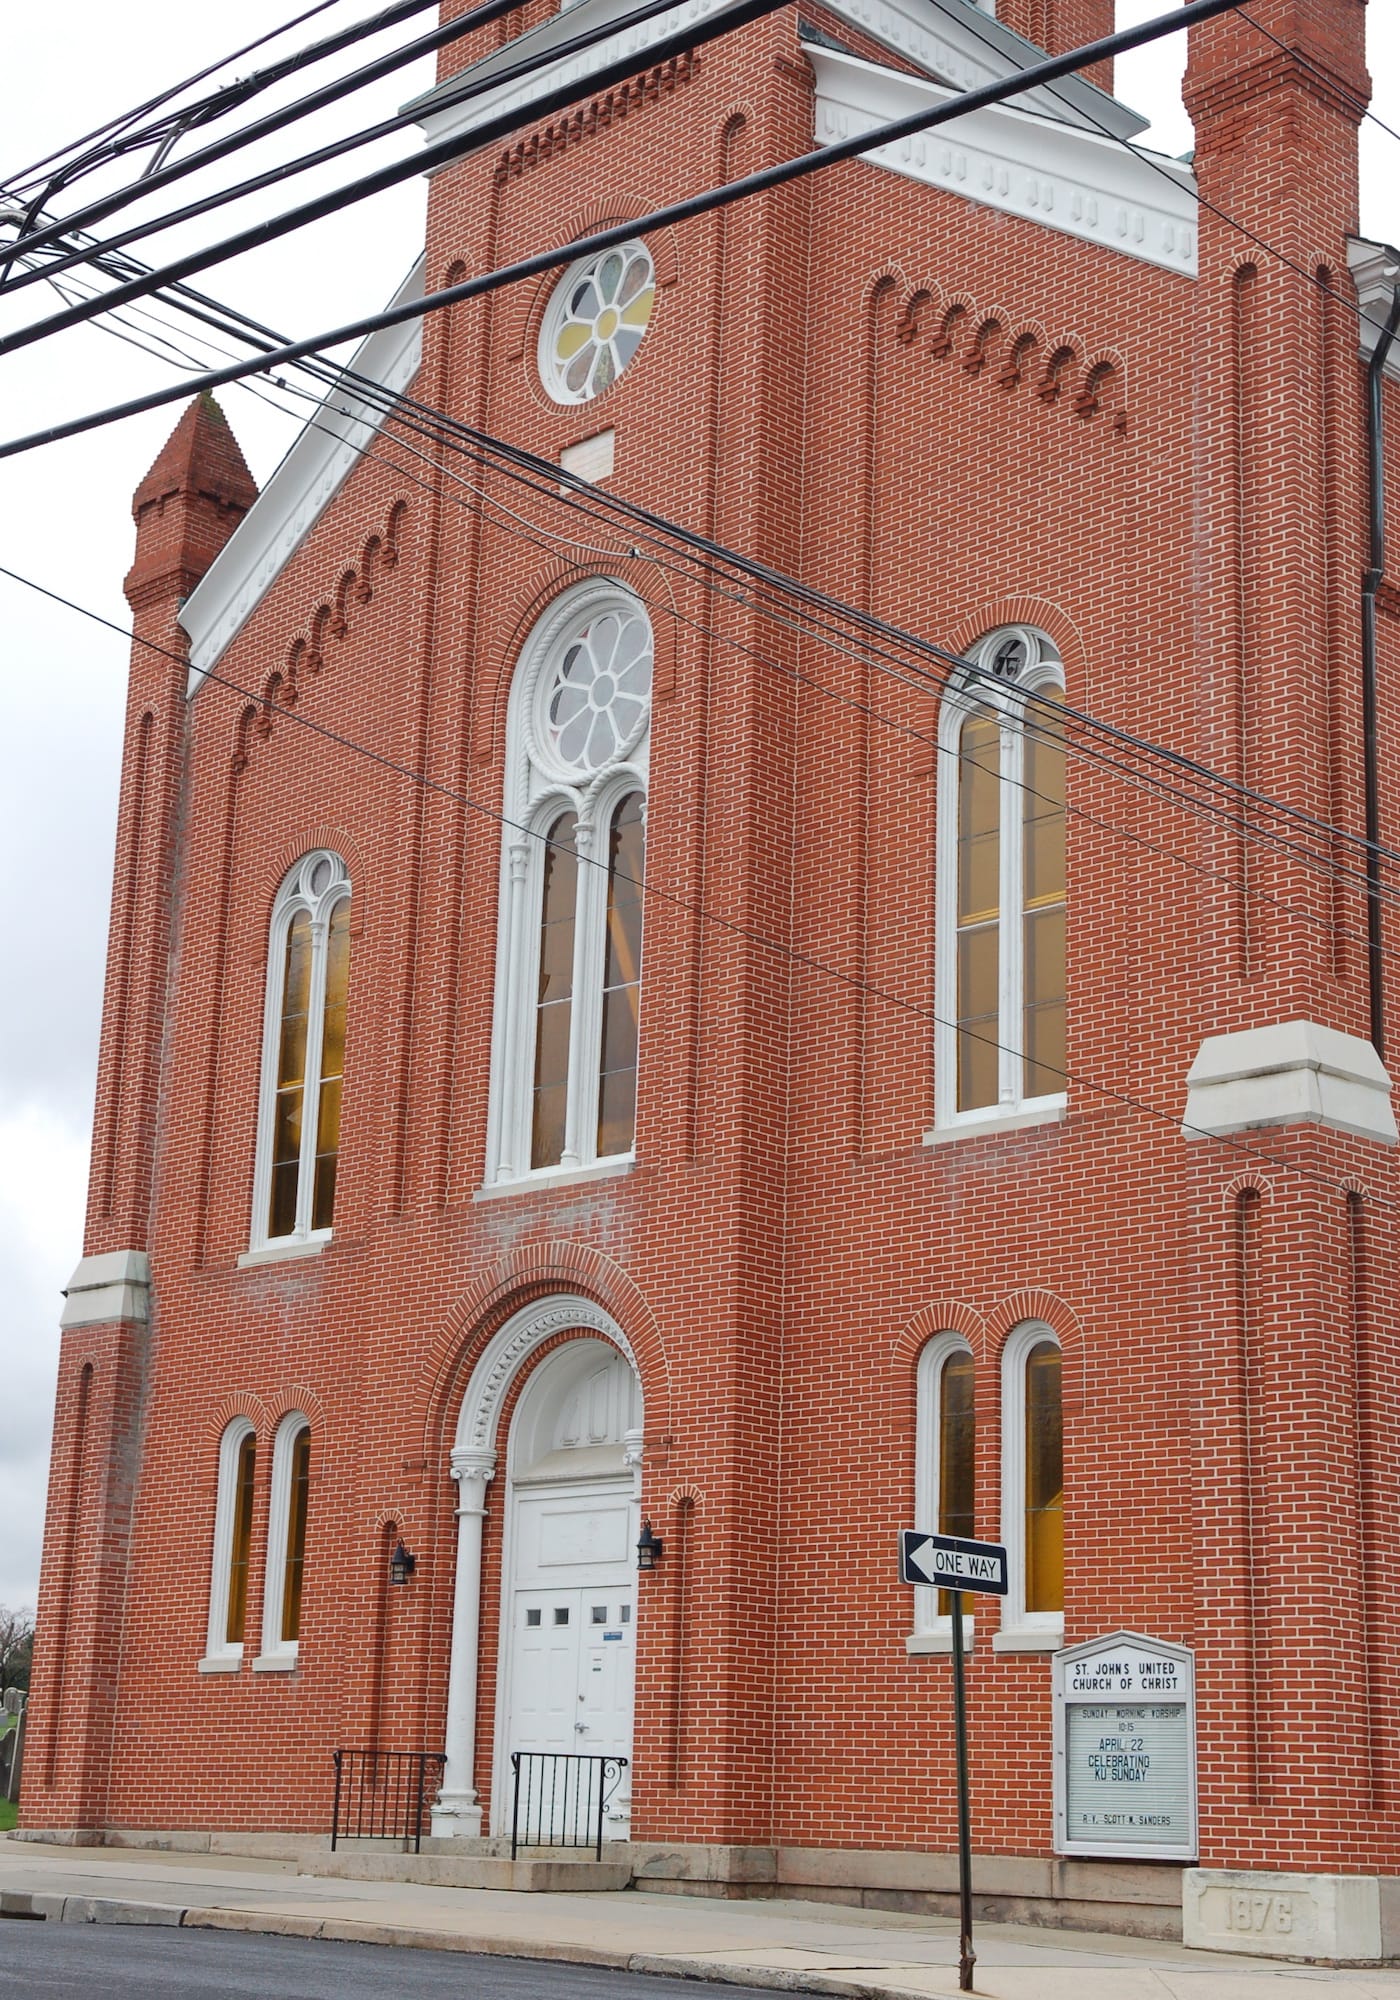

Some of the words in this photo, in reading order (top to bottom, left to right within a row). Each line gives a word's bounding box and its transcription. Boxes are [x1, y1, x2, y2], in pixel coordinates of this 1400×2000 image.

[936, 1552, 963, 1573] ONE
[969, 1557, 996, 1578] WAY
[1075, 1664, 1090, 1675] ST.
[1139, 1662, 1175, 1675] UNITED
[1072, 1678, 1112, 1690] CHURCH
[1120, 1678, 1133, 1690] OF
[1141, 1677, 1178, 1690] CHRIST
[1082, 1709, 1108, 1719] SUNDAY
[1116, 1708, 1146, 1719] MORNING
[1151, 1708, 1180, 1719] WORSHIP
[1118, 1722, 1135, 1732] 10:15
[1131, 1739, 1144, 1751] 22
[1088, 1755, 1150, 1768] CELEBRATING
[1095, 1768, 1107, 1781] KU
[1111, 1768, 1147, 1781] SUNDAY
[1104, 1814, 1126, 1824] SCOTT
[1139, 1815, 1171, 1825] SANDERS
[1224, 1894, 1293, 1934] 1876
